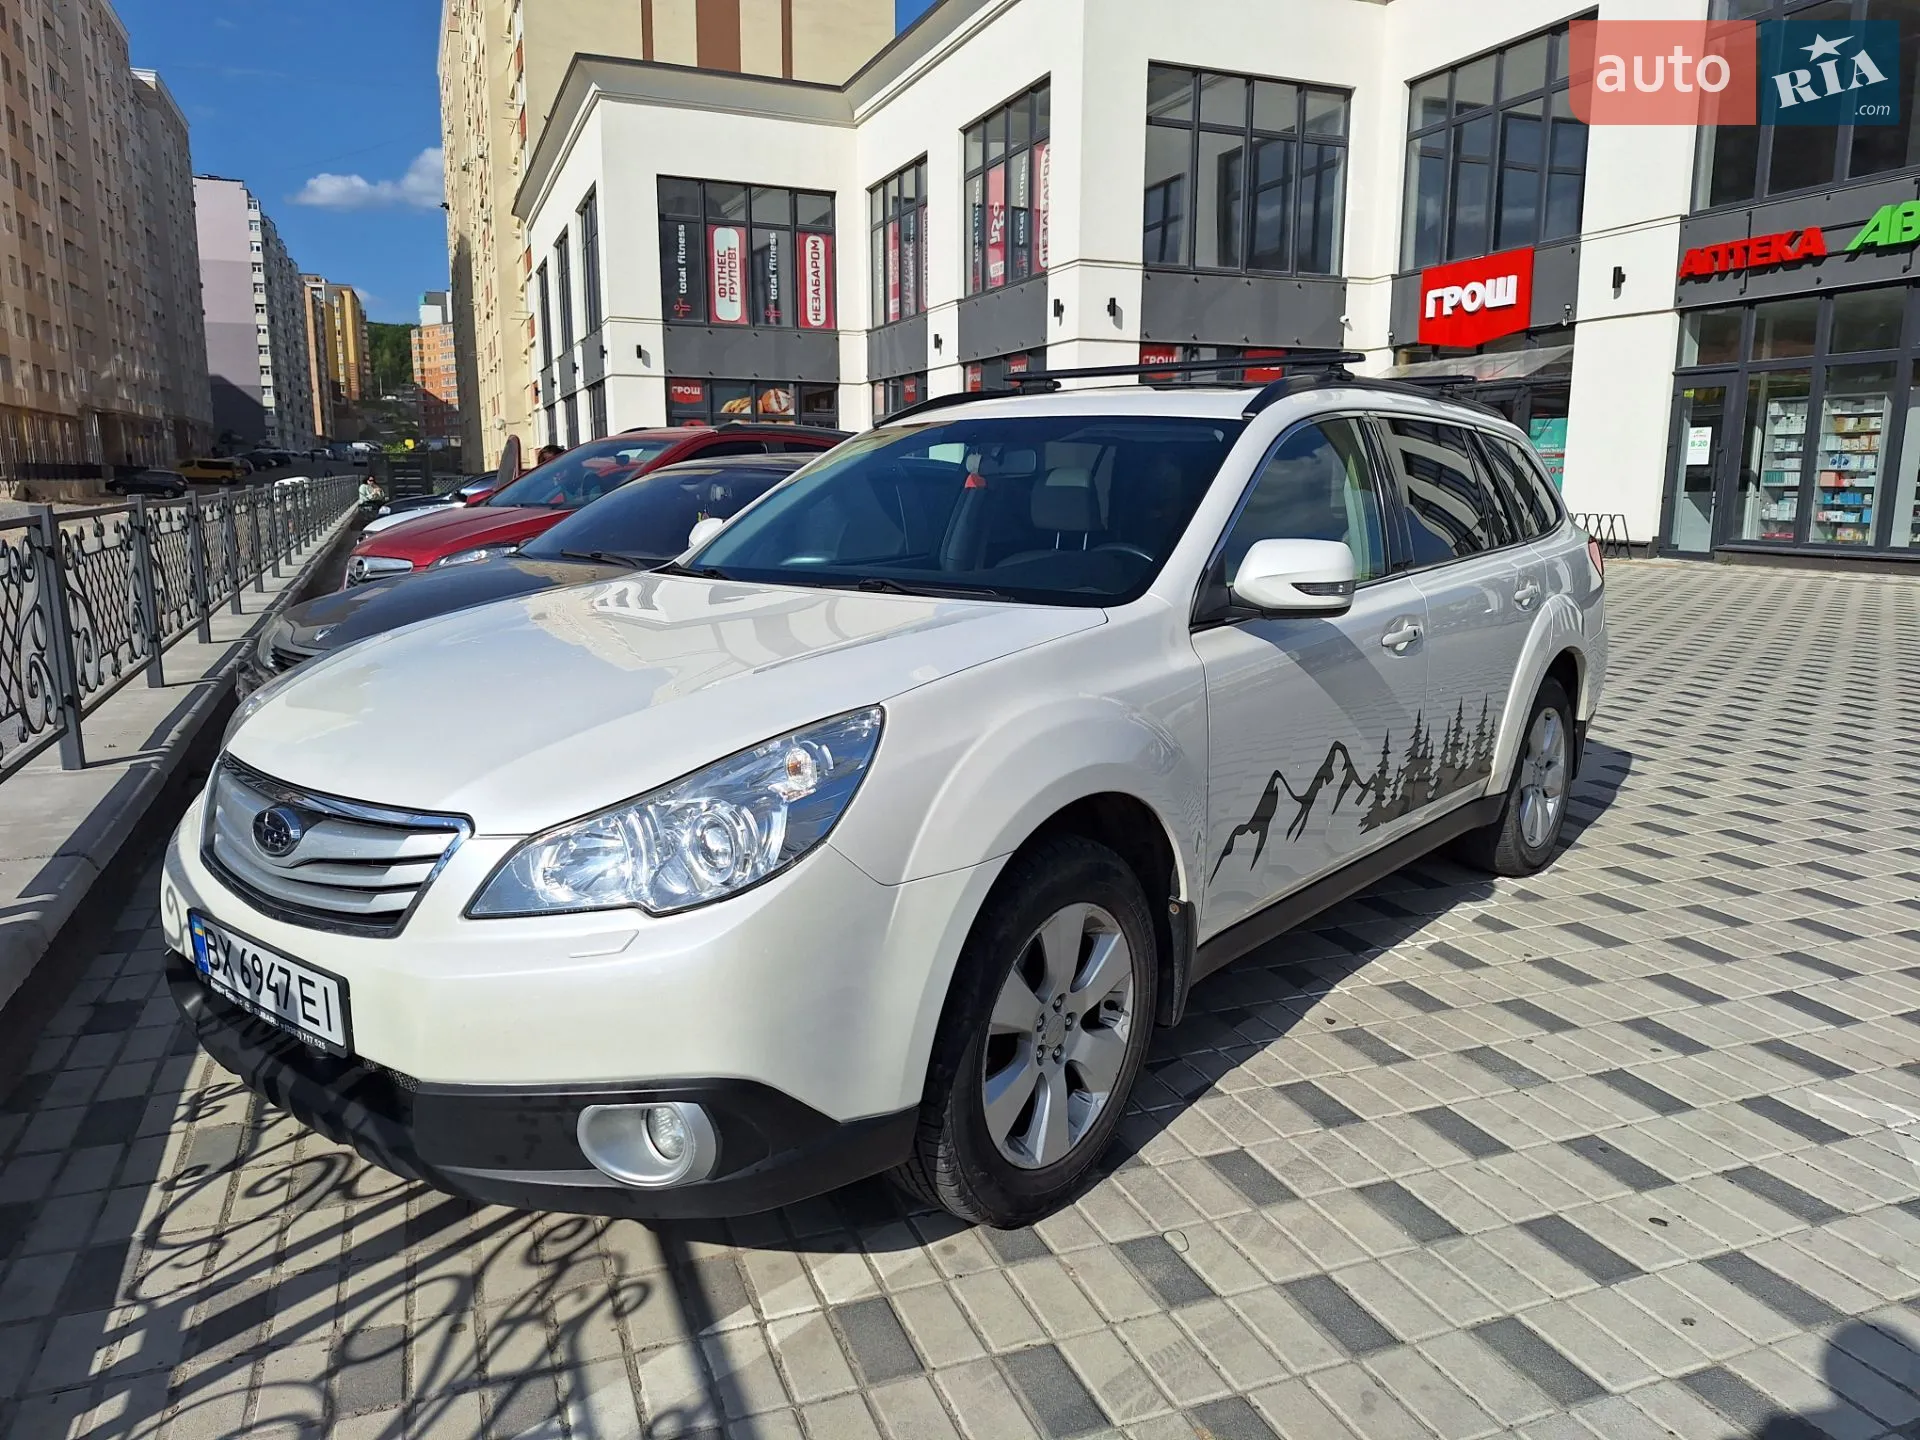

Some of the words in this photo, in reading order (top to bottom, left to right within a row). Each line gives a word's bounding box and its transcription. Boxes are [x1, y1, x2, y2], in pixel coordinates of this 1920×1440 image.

[677, 224, 686, 264] fitness
[768, 232, 777, 271] fitness
[1679, 226, 1827, 279] АПТЕКА
[678, 264, 687, 294] total
[717, 249, 727, 298] ФІТНЕС
[728, 246, 737, 303] ГРУПОВІ
[769, 273, 778, 300] total
[810, 239, 821, 322] НЕЗАБАРОМ
[1425, 274, 1518, 319] ГРОШ
[671, 385, 701, 395] ГРОШ
[204, 926, 236, 983] BX
[240, 948, 291, 1010] 6947
[298, 974, 333, 1032] EI
